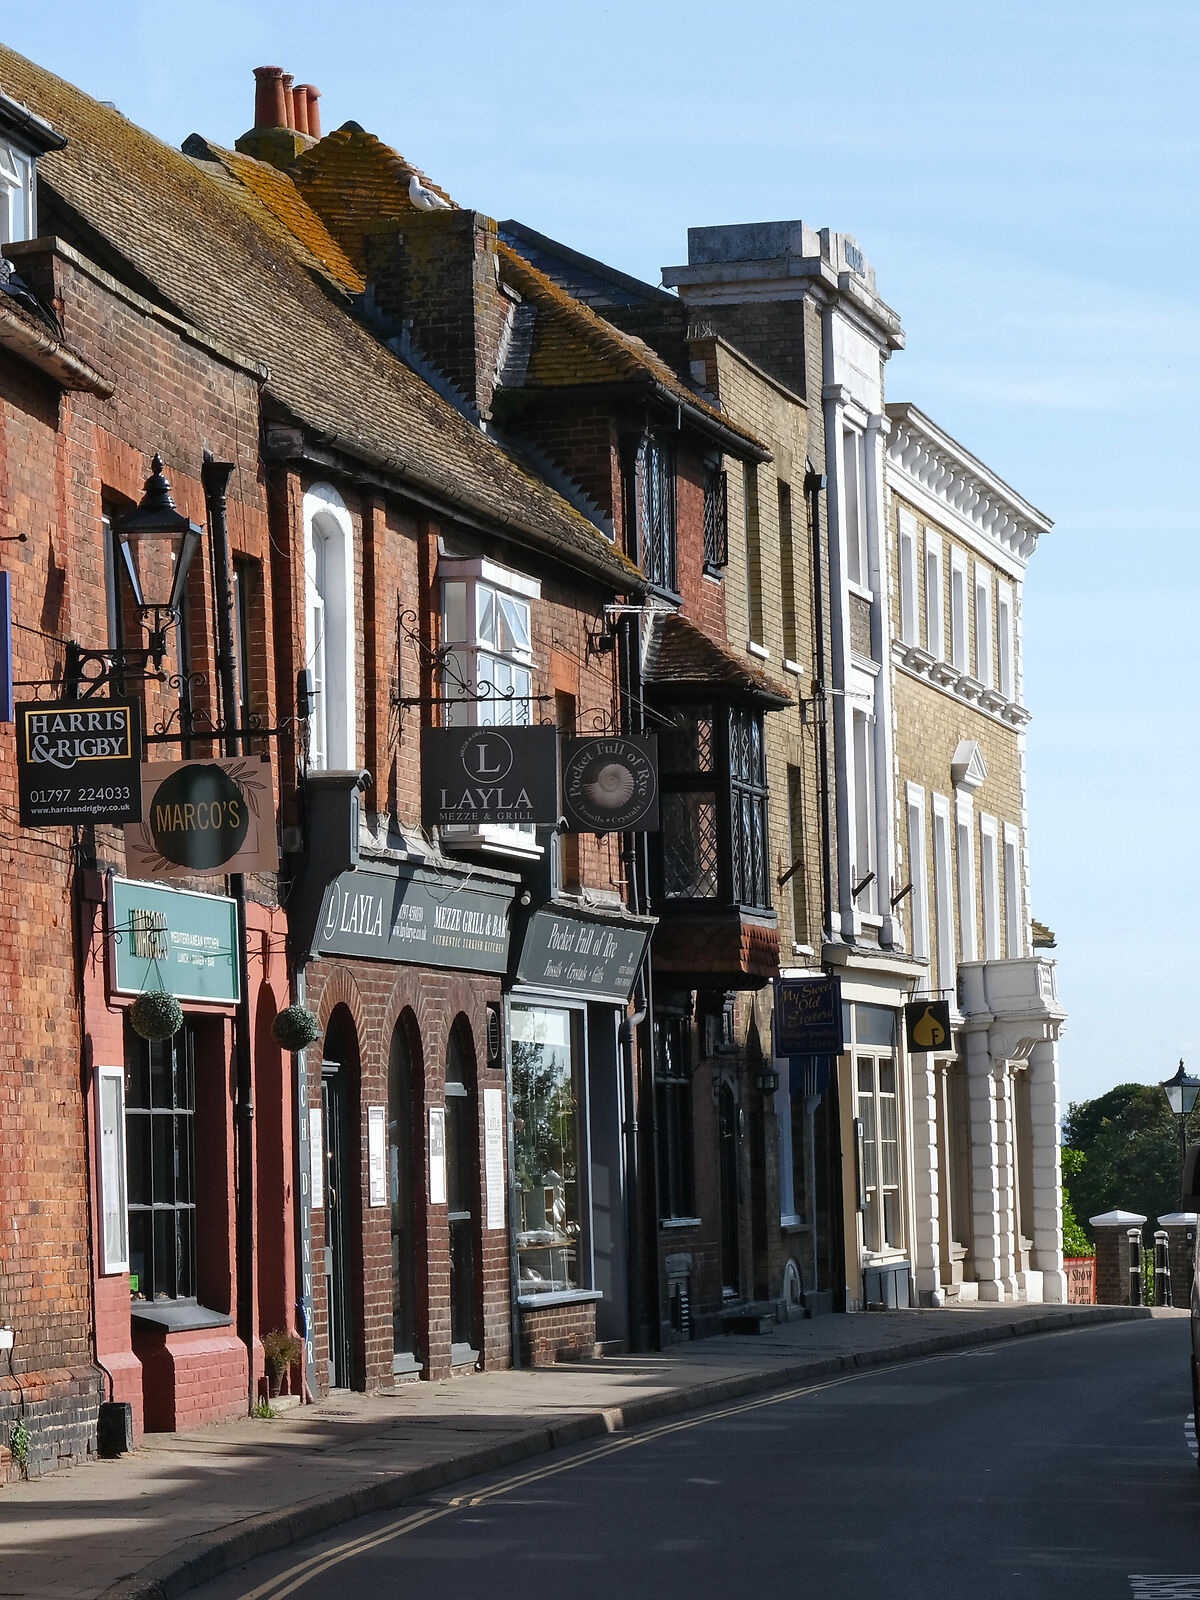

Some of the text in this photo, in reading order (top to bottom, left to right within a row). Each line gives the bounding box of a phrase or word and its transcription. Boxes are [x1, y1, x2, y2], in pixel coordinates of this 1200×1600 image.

[30, 711, 126, 734] HARRIS
[476, 743, 501, 773] L
[570, 742, 650, 797] Pocket Full of Rye
[30, 786, 131, 803] 01797 224033
[439, 787, 534, 810] LAYLA
[30, 803, 131, 815] www.harrisandrigby.co.uk
[156, 800, 241, 833] MARCO'S
[440, 811, 534, 821] MEZZE & GRILL
[340, 892, 383, 937] LAYLA
[433, 906, 508, 938] MEZZE GRILL & BAR
[432, 934, 461, 948] AUTHENTIC
[547, 923, 618, 964] Pocket Full of Rye
[780, 982, 834, 1005] My Sweet
[798, 996, 821, 1011] Old
